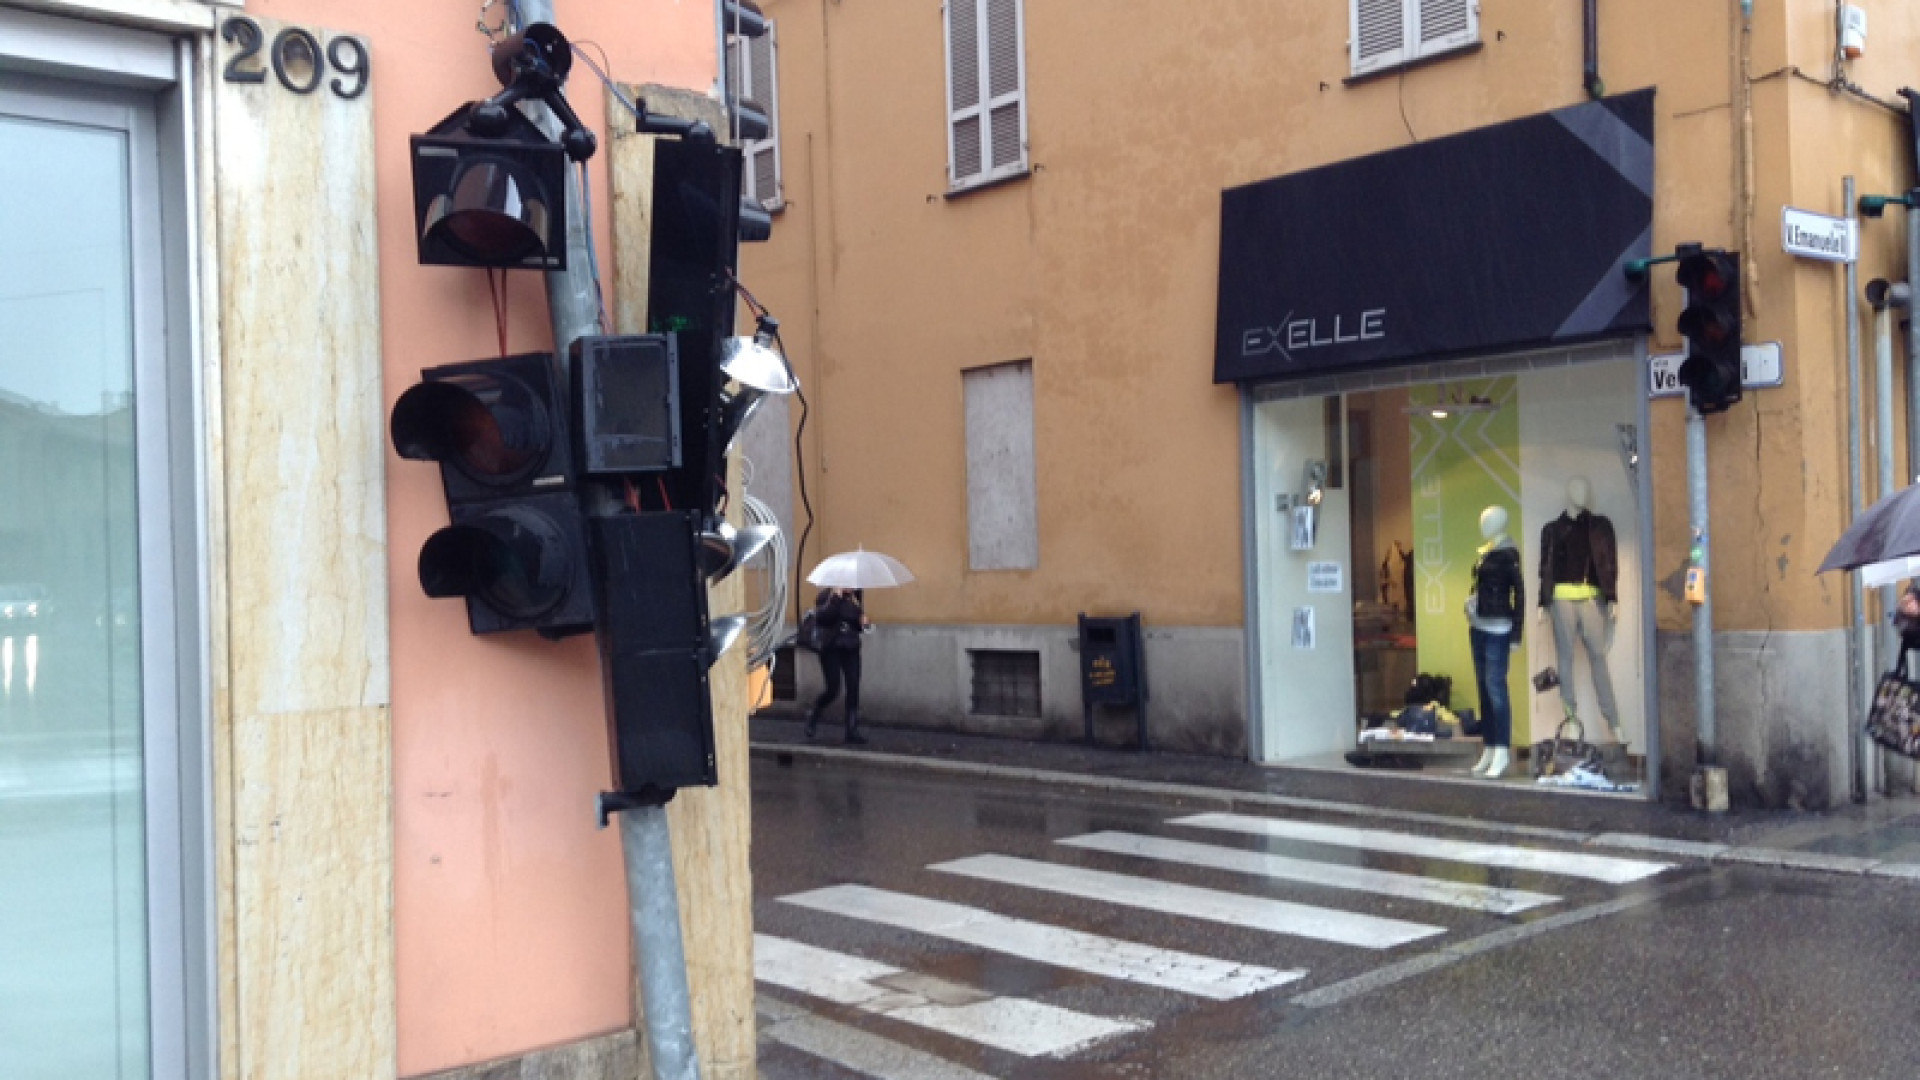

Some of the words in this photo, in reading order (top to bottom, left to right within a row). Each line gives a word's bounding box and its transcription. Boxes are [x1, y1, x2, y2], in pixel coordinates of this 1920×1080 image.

[221, 16, 370, 100] 209
[1242, 307, 1386, 361] EXELLE
[1417, 474, 1451, 613] EXELLE
